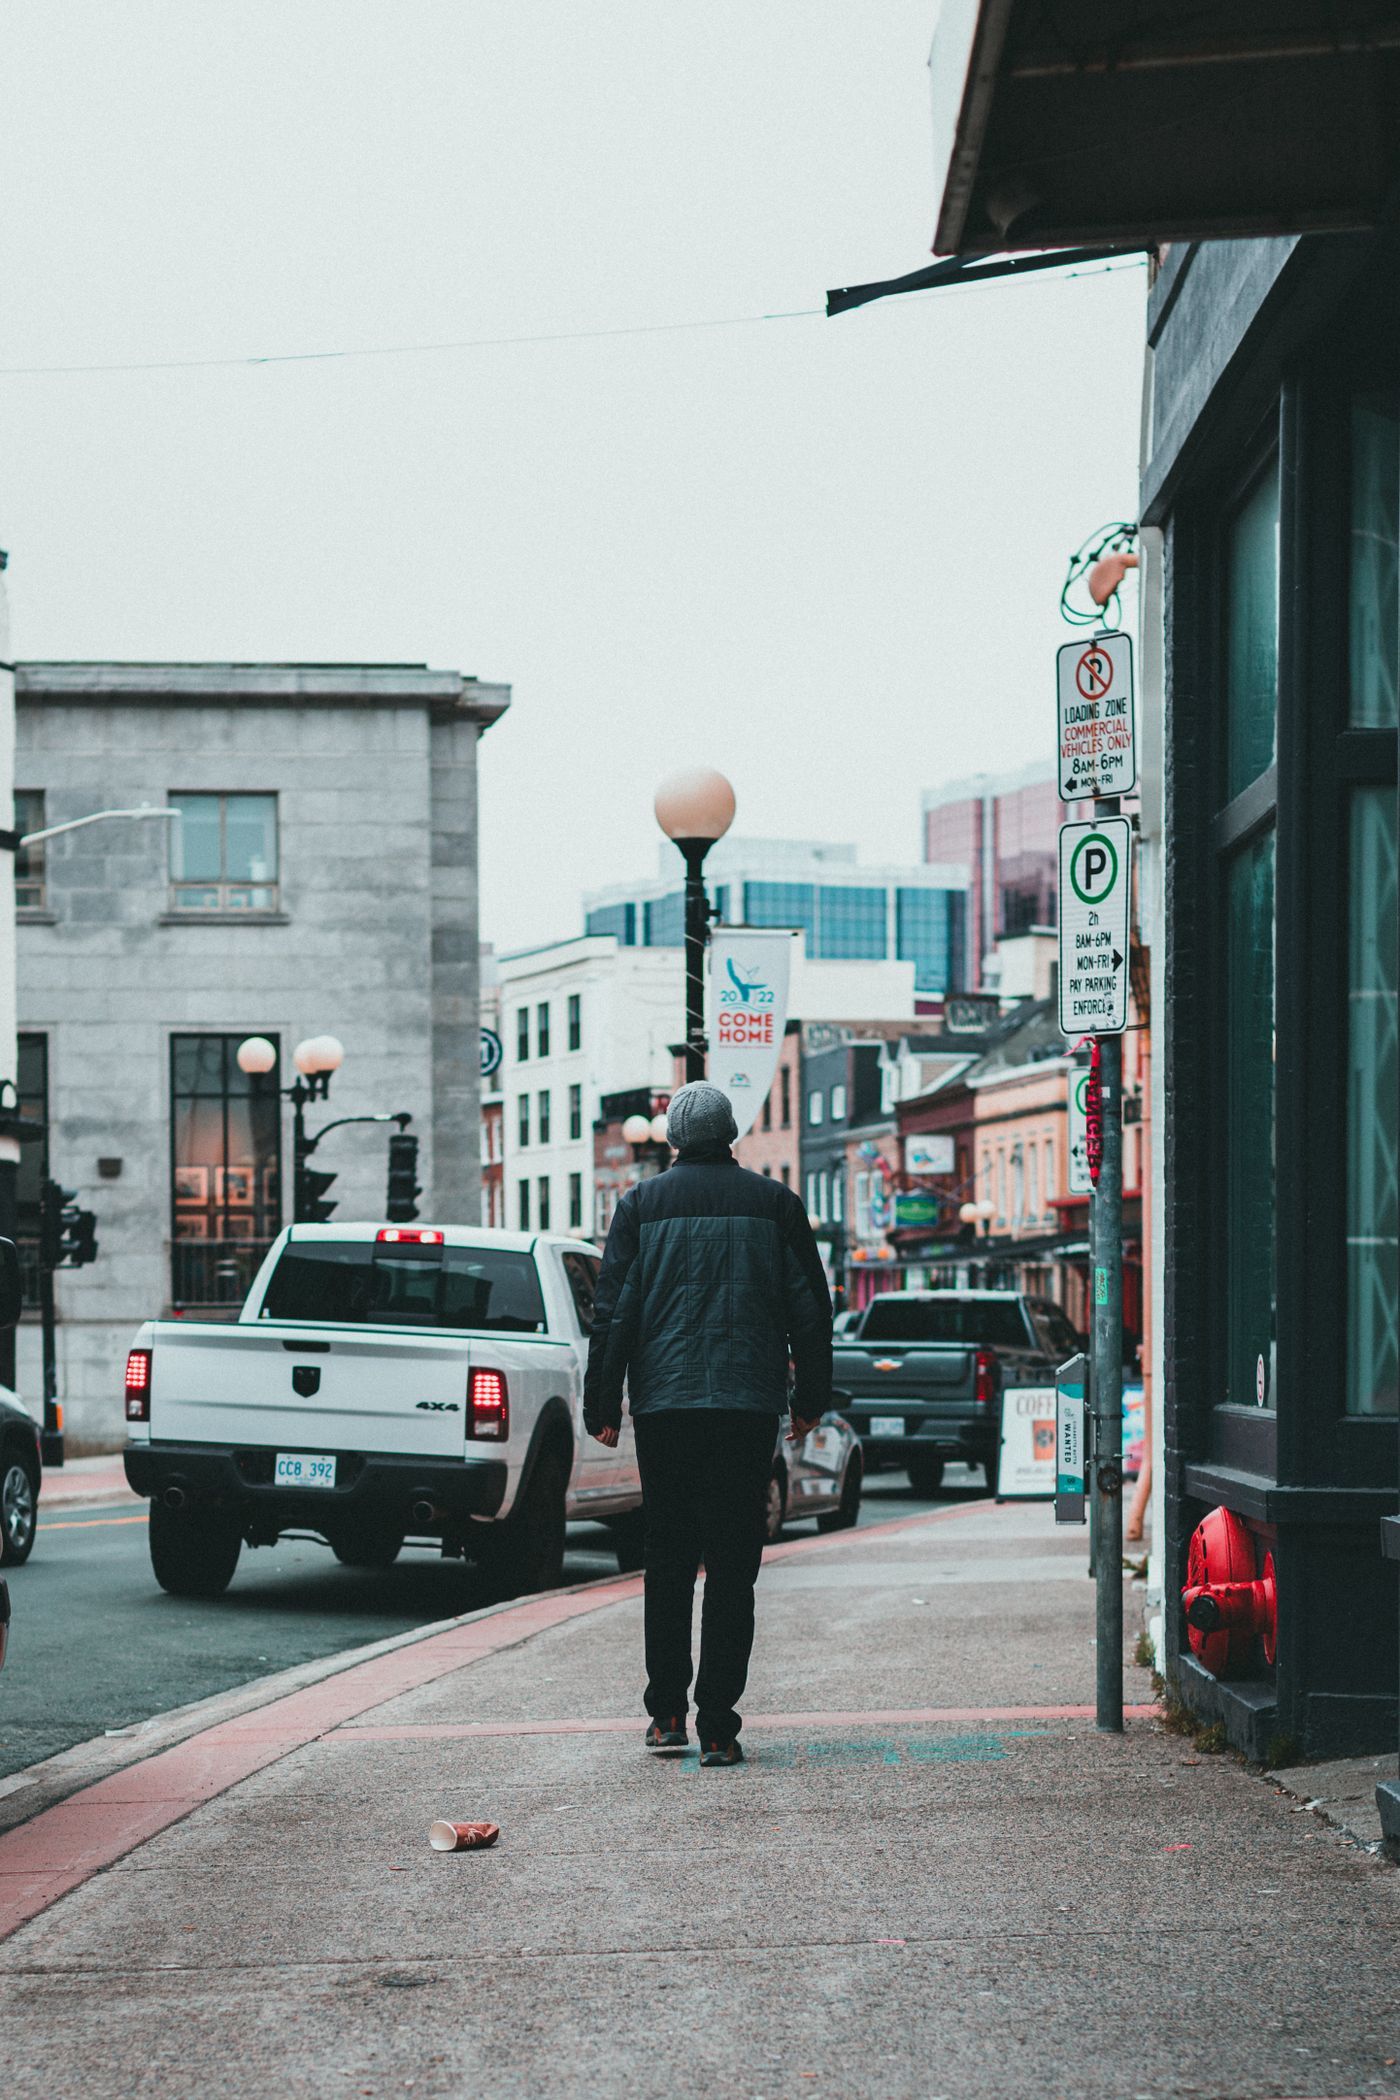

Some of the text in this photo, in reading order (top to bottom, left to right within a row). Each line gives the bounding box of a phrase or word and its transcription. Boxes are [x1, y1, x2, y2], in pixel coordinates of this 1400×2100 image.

[1065, 697, 1127, 724] LOADING ZONE
[1065, 718, 1128, 741] COMMERCIAL
[1061, 733, 1132, 758] VEHICLES ONLY
[1085, 848, 1107, 890] P
[1088, 911, 1099, 926] 2h
[1075, 931, 1112, 949] 8AM-6PM
[1077, 954, 1110, 971] MON-FRI
[1070, 975, 1117, 993] PAY PARKING
[720, 990, 775, 1003] 20 22
[1073, 998, 1113, 1016] ENFORCE
[718, 1012, 774, 1028] COME
[719, 1028, 774, 1044] HOME
[1016, 1394, 1053, 1416] COFF
[1064, 1423, 1072, 1463] WANTED
[309, 1462, 333, 1479] 392
